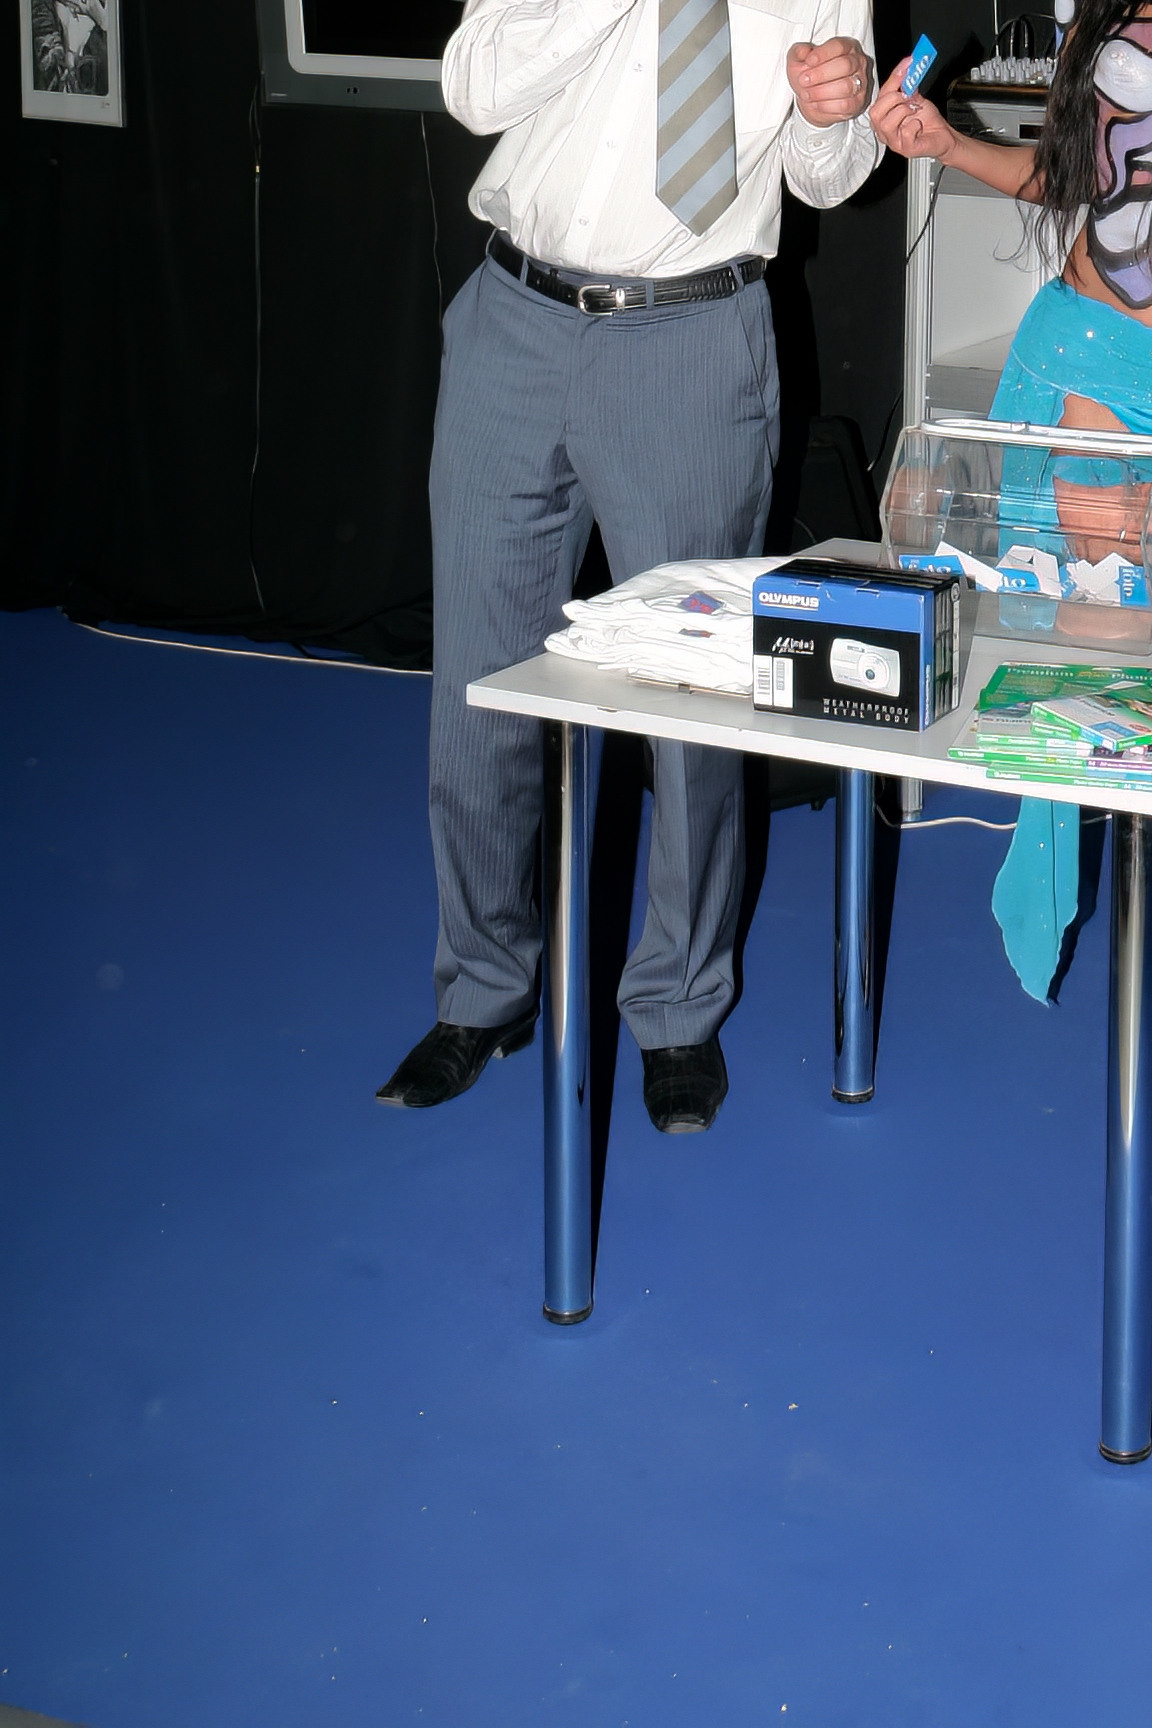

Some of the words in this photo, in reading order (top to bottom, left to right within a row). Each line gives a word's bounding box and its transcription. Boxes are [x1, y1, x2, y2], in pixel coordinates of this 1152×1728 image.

[759, 592, 819, 608] OLYMPUS
[823, 698, 909, 715] WEATHERPROOF
[823, 706, 865, 719] METAL
[875, 712, 909, 724] BODY
